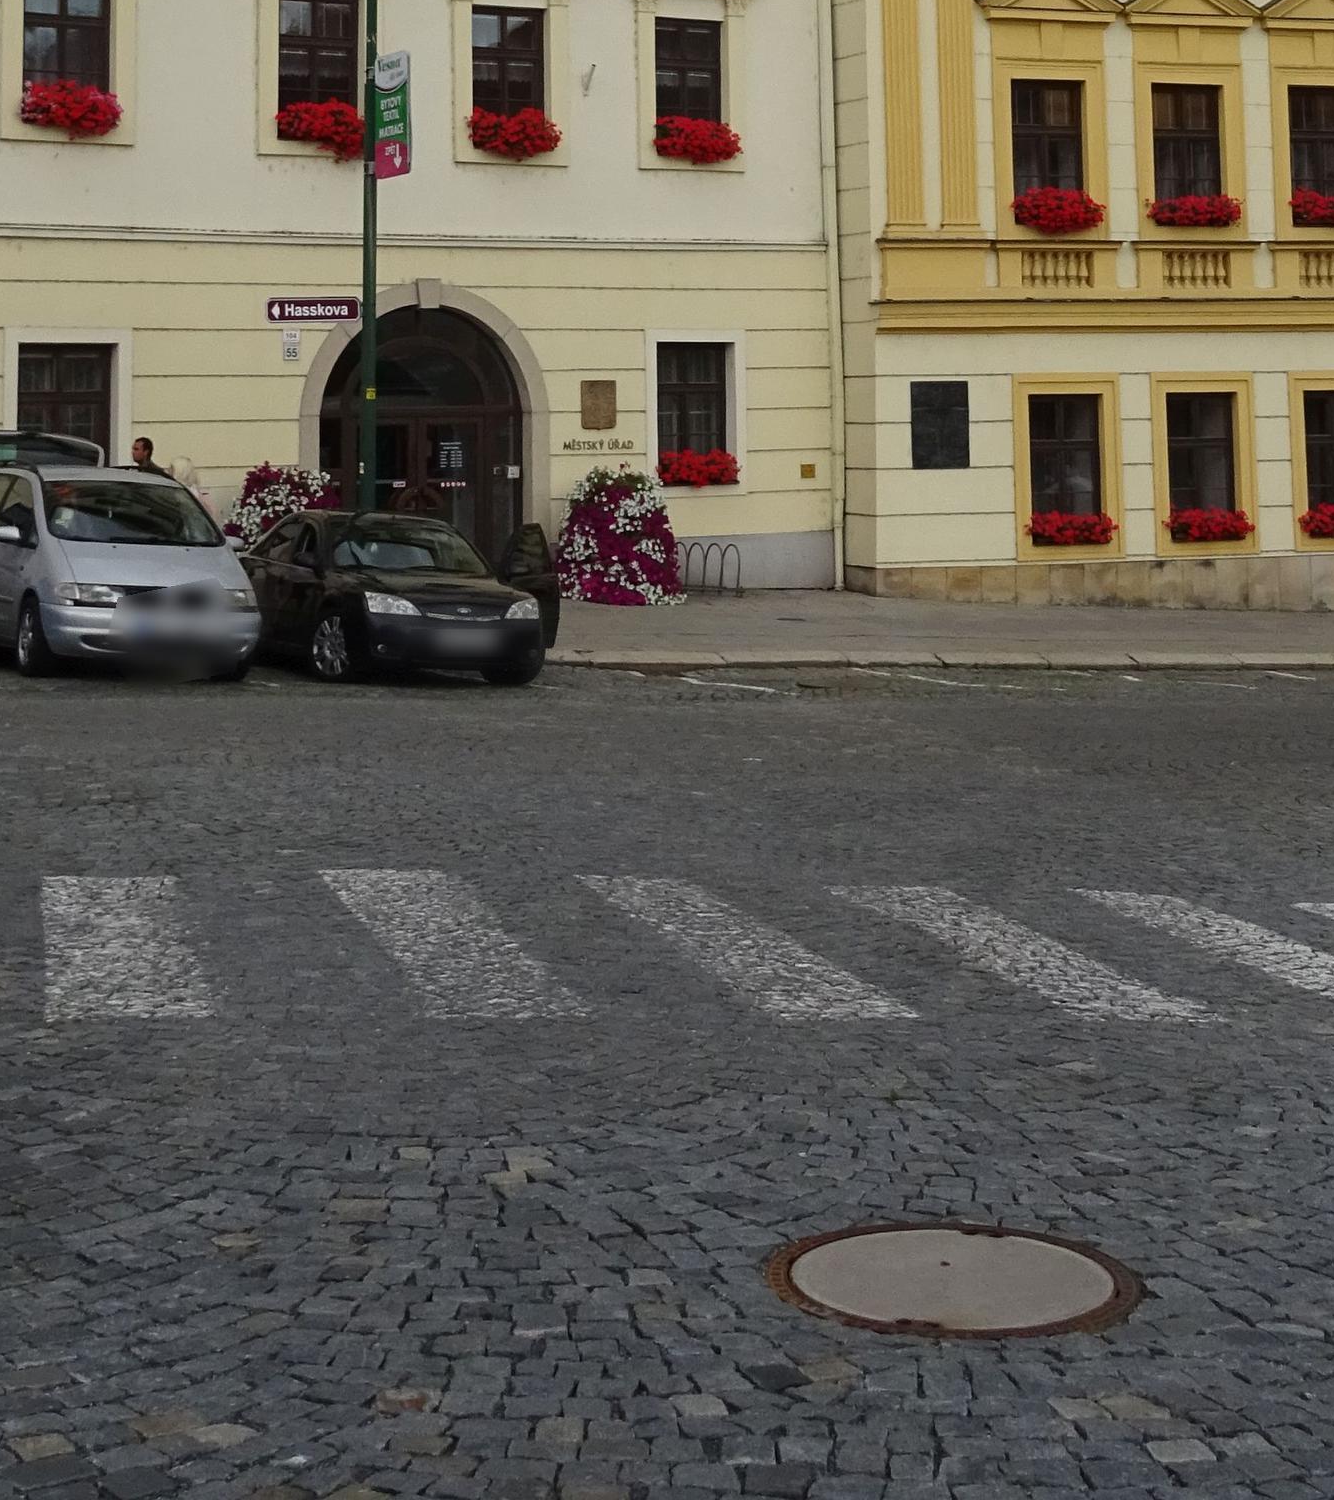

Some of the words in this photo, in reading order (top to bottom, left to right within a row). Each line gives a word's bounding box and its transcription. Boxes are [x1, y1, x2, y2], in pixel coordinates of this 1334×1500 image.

[284, 303, 349, 317] Hasskova
[287, 347, 298, 358] 55
[563, 439, 604, 451] MĚSTSKÝ
